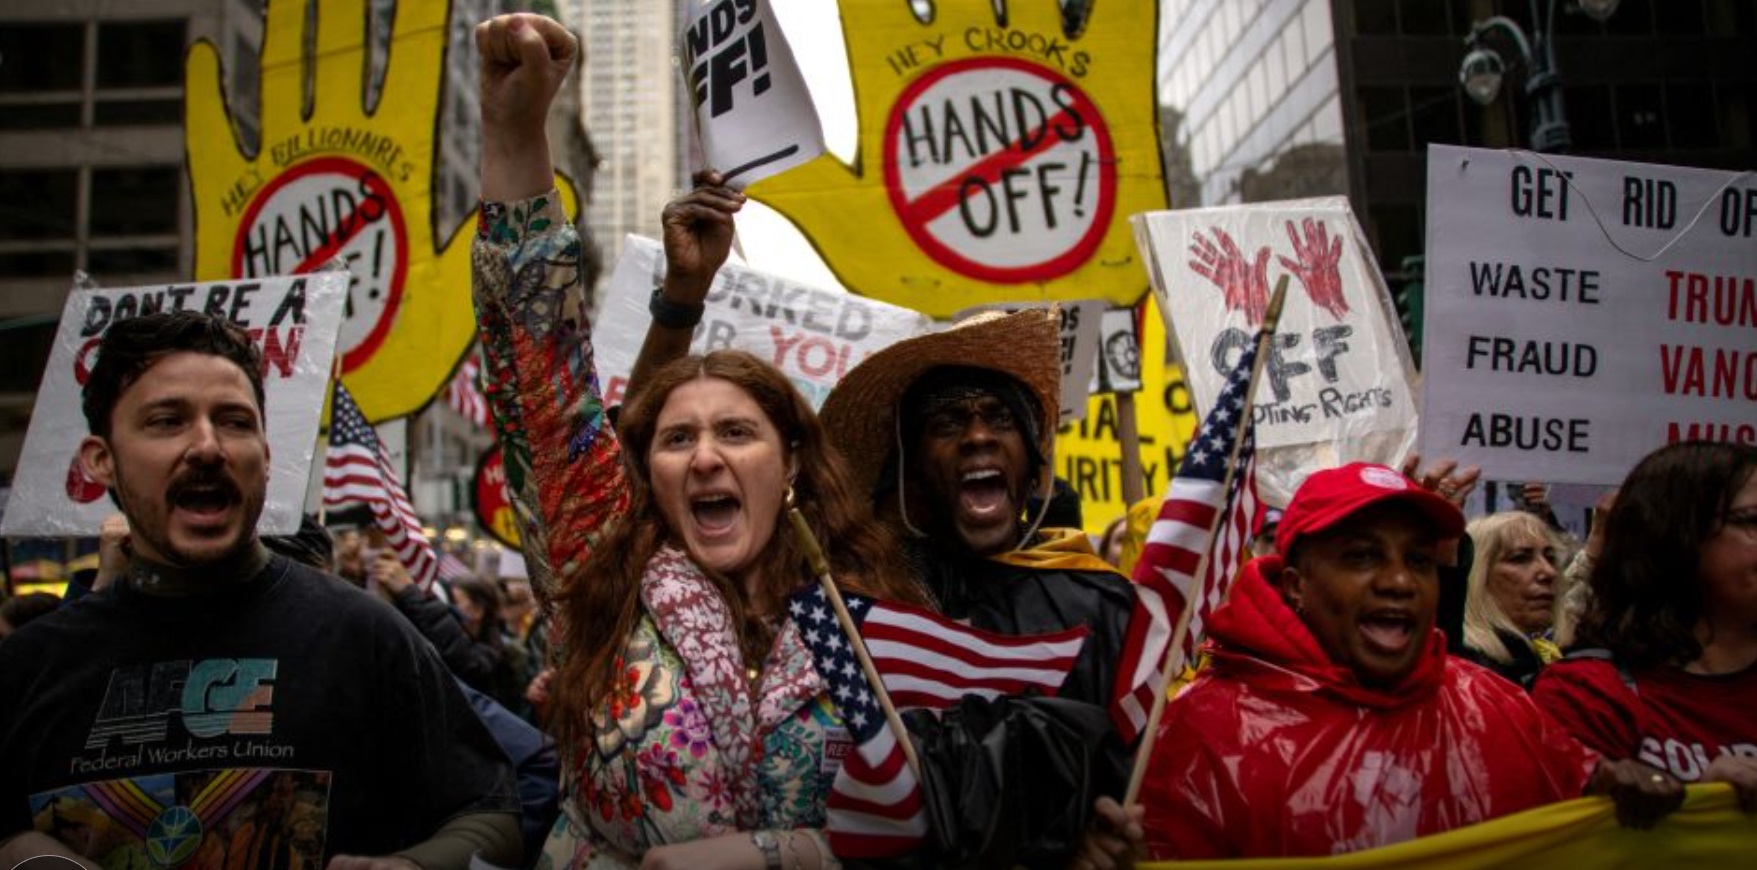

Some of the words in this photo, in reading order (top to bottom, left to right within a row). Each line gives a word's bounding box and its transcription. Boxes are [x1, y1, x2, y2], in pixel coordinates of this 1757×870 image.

[886, 35, 943, 75] HEY
[964, 27, 1091, 78] CROOKS
[903, 82, 1084, 168] HANDS
[959, 151, 1089, 239] OFF!
[1510, 164, 1573, 221] GET
[1622, 176, 1677, 230] RID
[244, 170, 386, 280] HANDS
[203, 283, 261, 327] BE
[269, 278, 308, 326] A
[704, 264, 874, 342] ORKED
[1469, 261, 1600, 304] WASTE
[1209, 324, 1354, 403] OFF
[1466, 335, 1597, 378] FRAUD
[1252, 401, 1317, 425] OTING
[1461, 413, 1590, 453] ABUSE
[70, 745, 143, 775] Federal
[148, 739, 229, 765] Workers
[233, 739, 295, 759] Union
